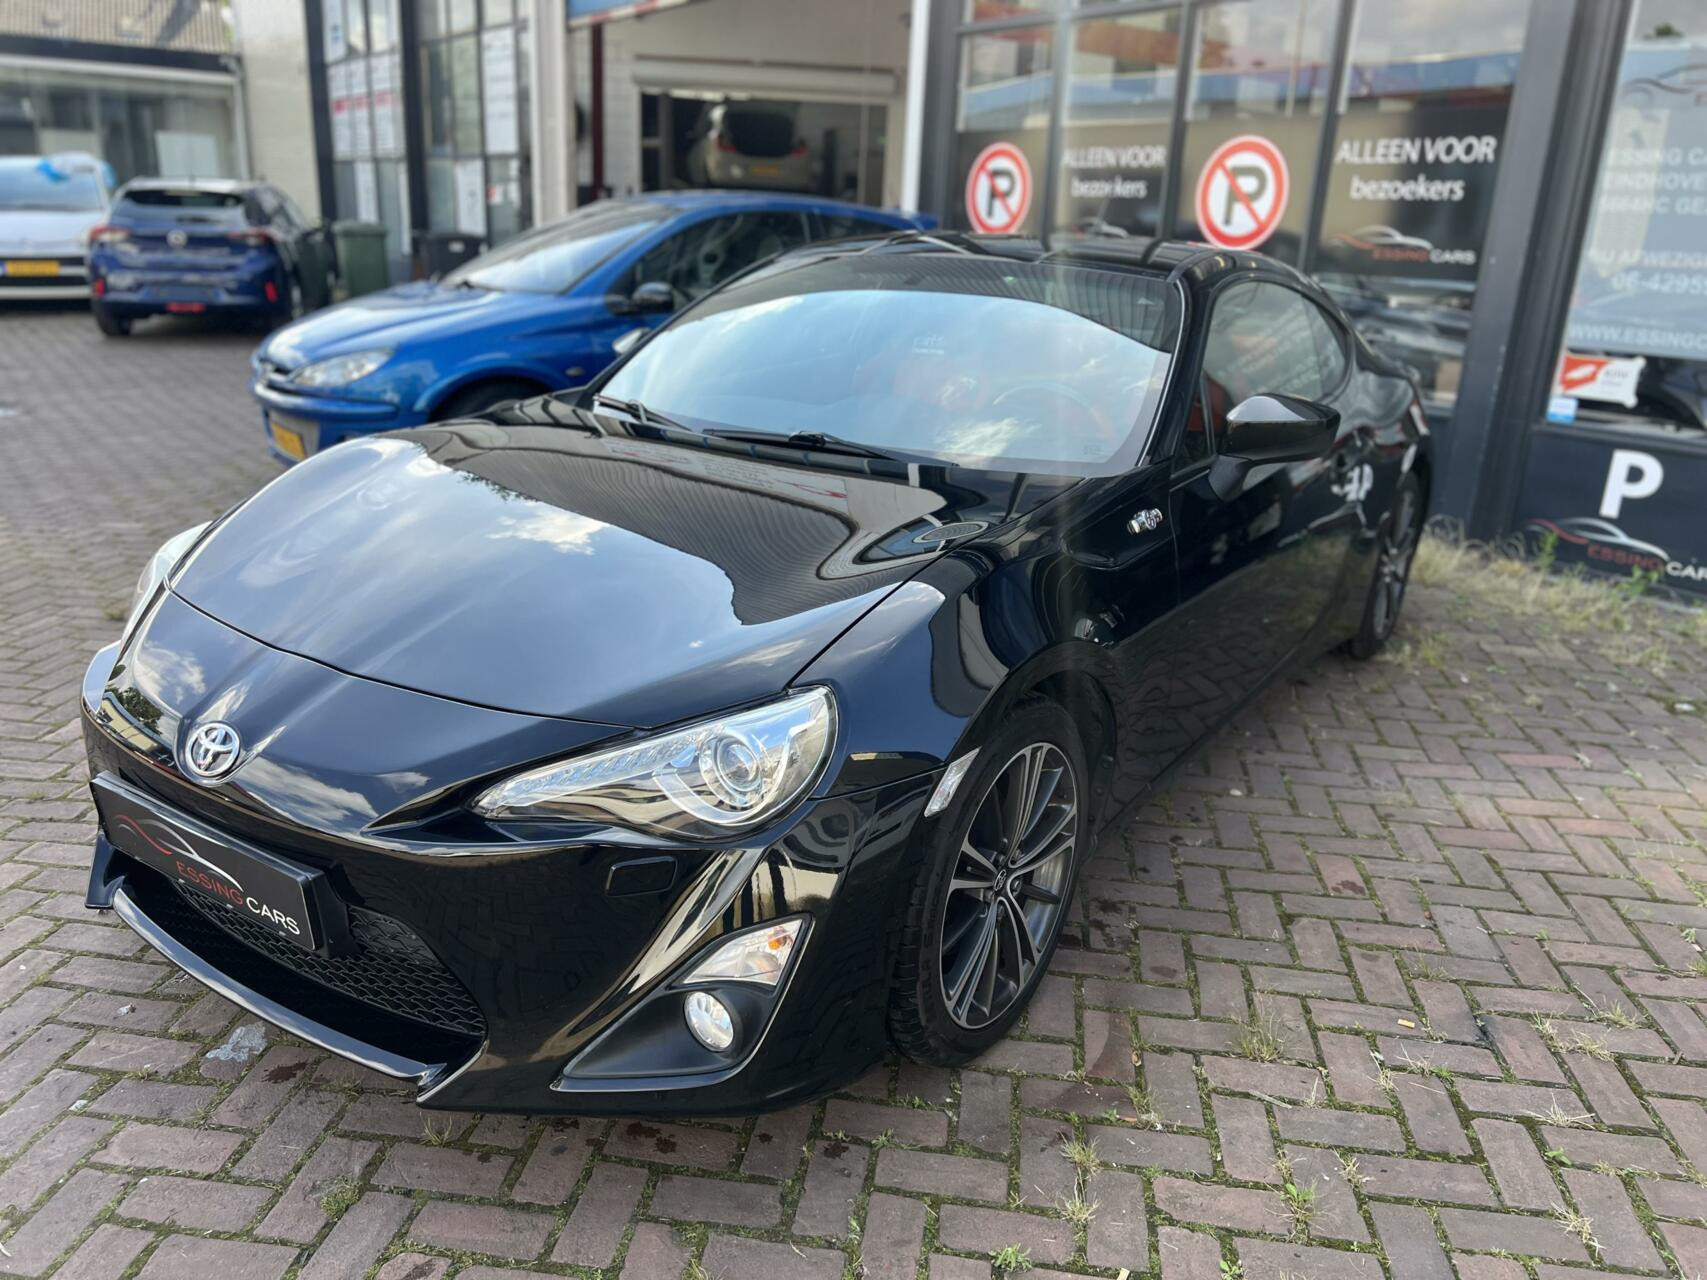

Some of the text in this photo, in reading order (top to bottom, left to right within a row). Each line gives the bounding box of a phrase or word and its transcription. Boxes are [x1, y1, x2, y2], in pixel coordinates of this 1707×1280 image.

[1117, 146, 1167, 168] VOOR
[1335, 136, 1498, 164] ALLEEN VOOR
[1350, 173, 1465, 201] bezoekers
[1430, 249, 1476, 265] CARS
[1600, 449, 1664, 519] P
[176, 861, 300, 935] ESSING CARS
